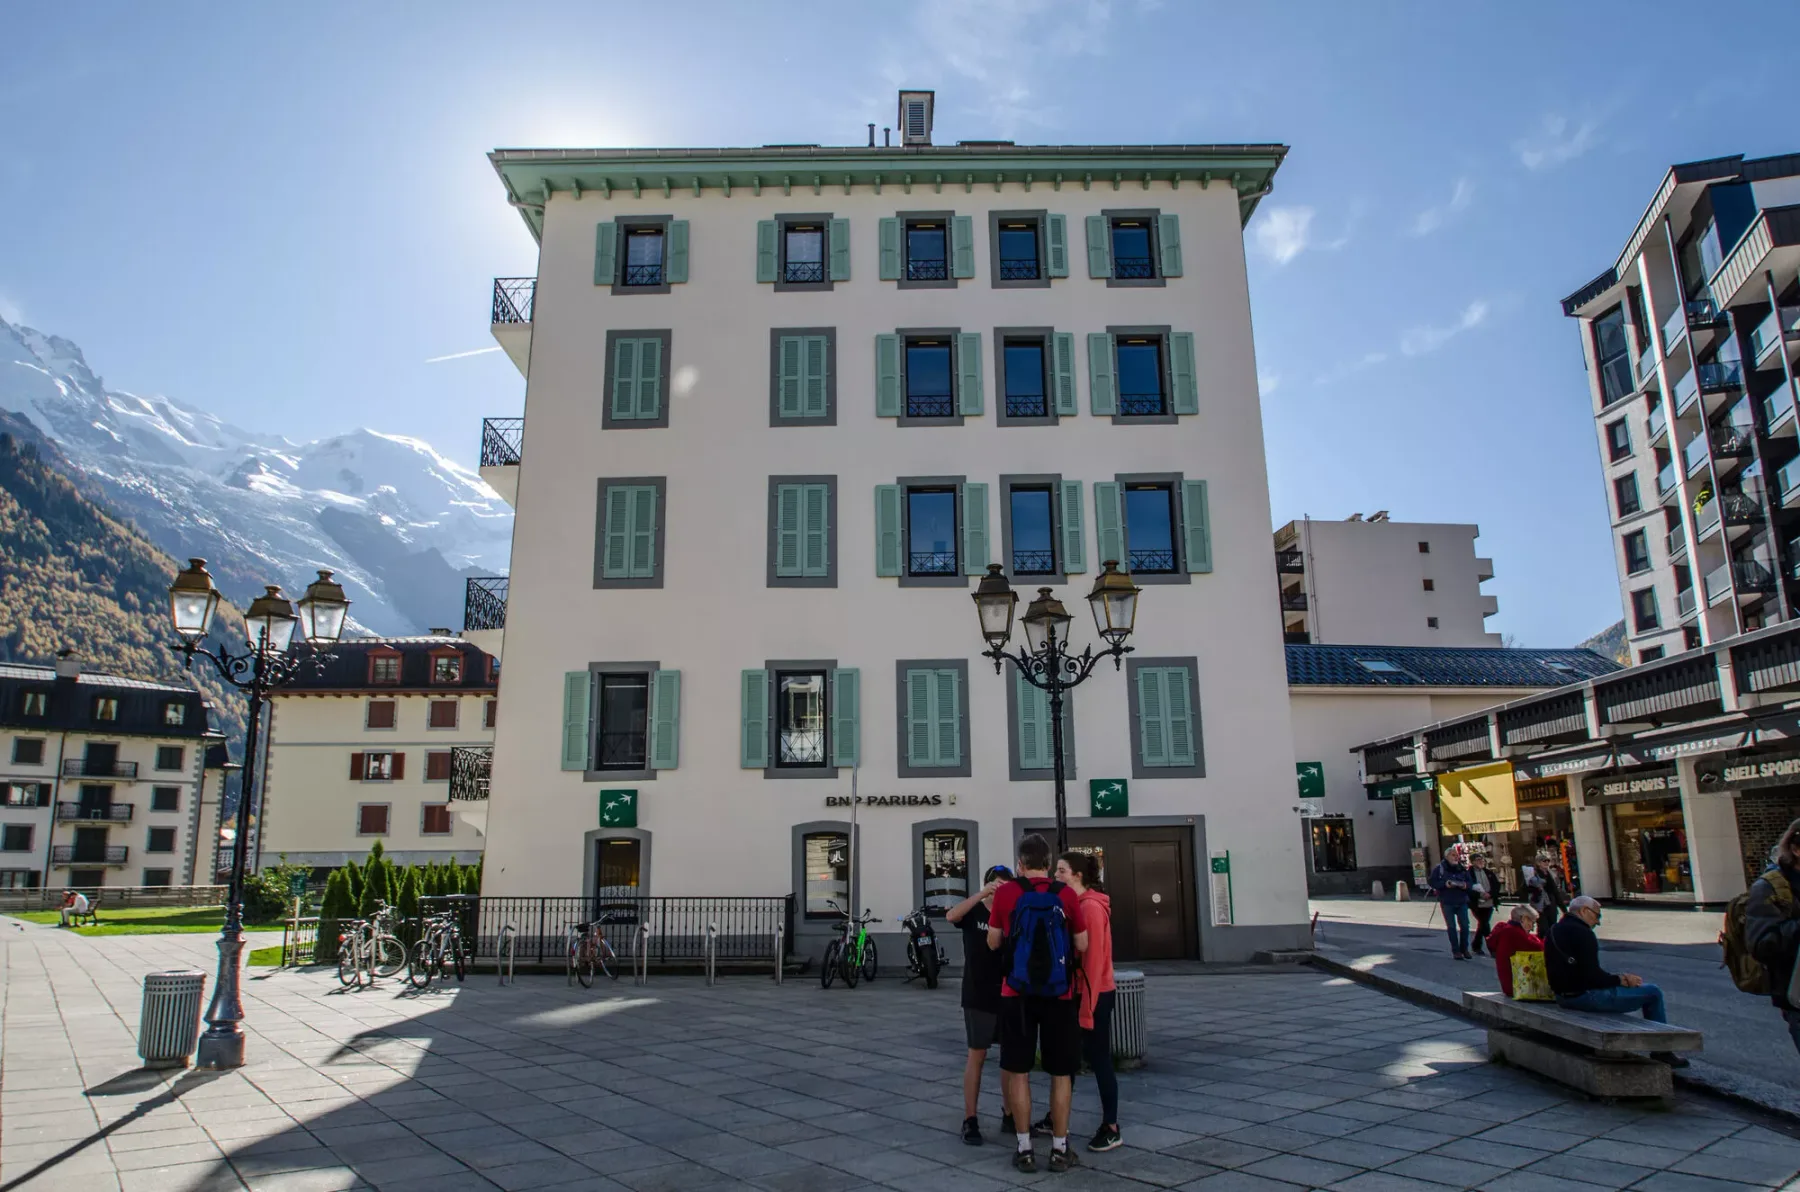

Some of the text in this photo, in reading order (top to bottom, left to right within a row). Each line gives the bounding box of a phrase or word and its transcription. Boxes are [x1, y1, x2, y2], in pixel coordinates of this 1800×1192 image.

[1724, 759, 1800, 782] SNELL SPORT
[1603, 781, 1630, 796] SNELL
[1630, 777, 1666, 794] SPORTS
[826, 795, 942, 807] BNP PARIBAS
